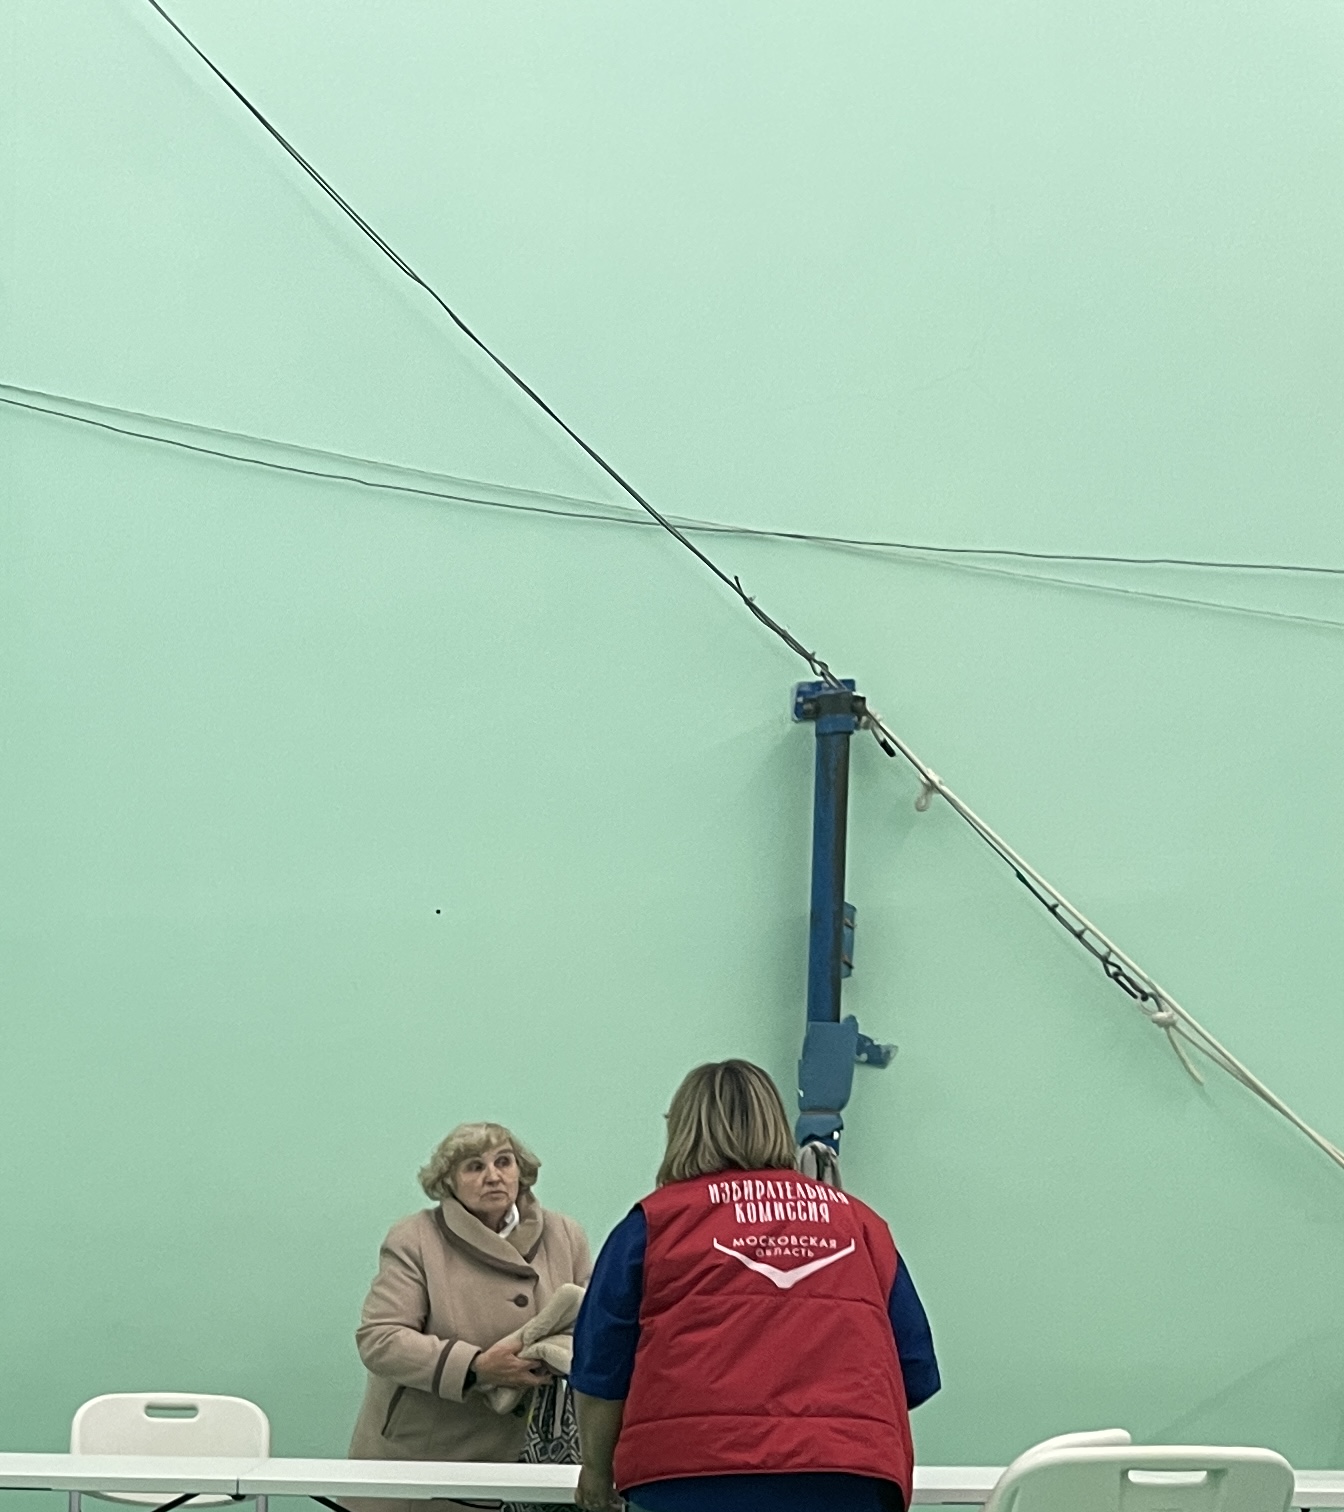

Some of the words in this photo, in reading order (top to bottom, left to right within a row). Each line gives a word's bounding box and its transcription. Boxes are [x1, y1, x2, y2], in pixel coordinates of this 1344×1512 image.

[708, 1179, 849, 1205] ИЗБИРАТЕЛЬНАЯ
[734, 1200, 830, 1223] КОМИССИЯ
[732, 1235, 837, 1249] МОСКОВСКАЯ
[755, 1247, 815, 1258] ОБЛАСТЬ
